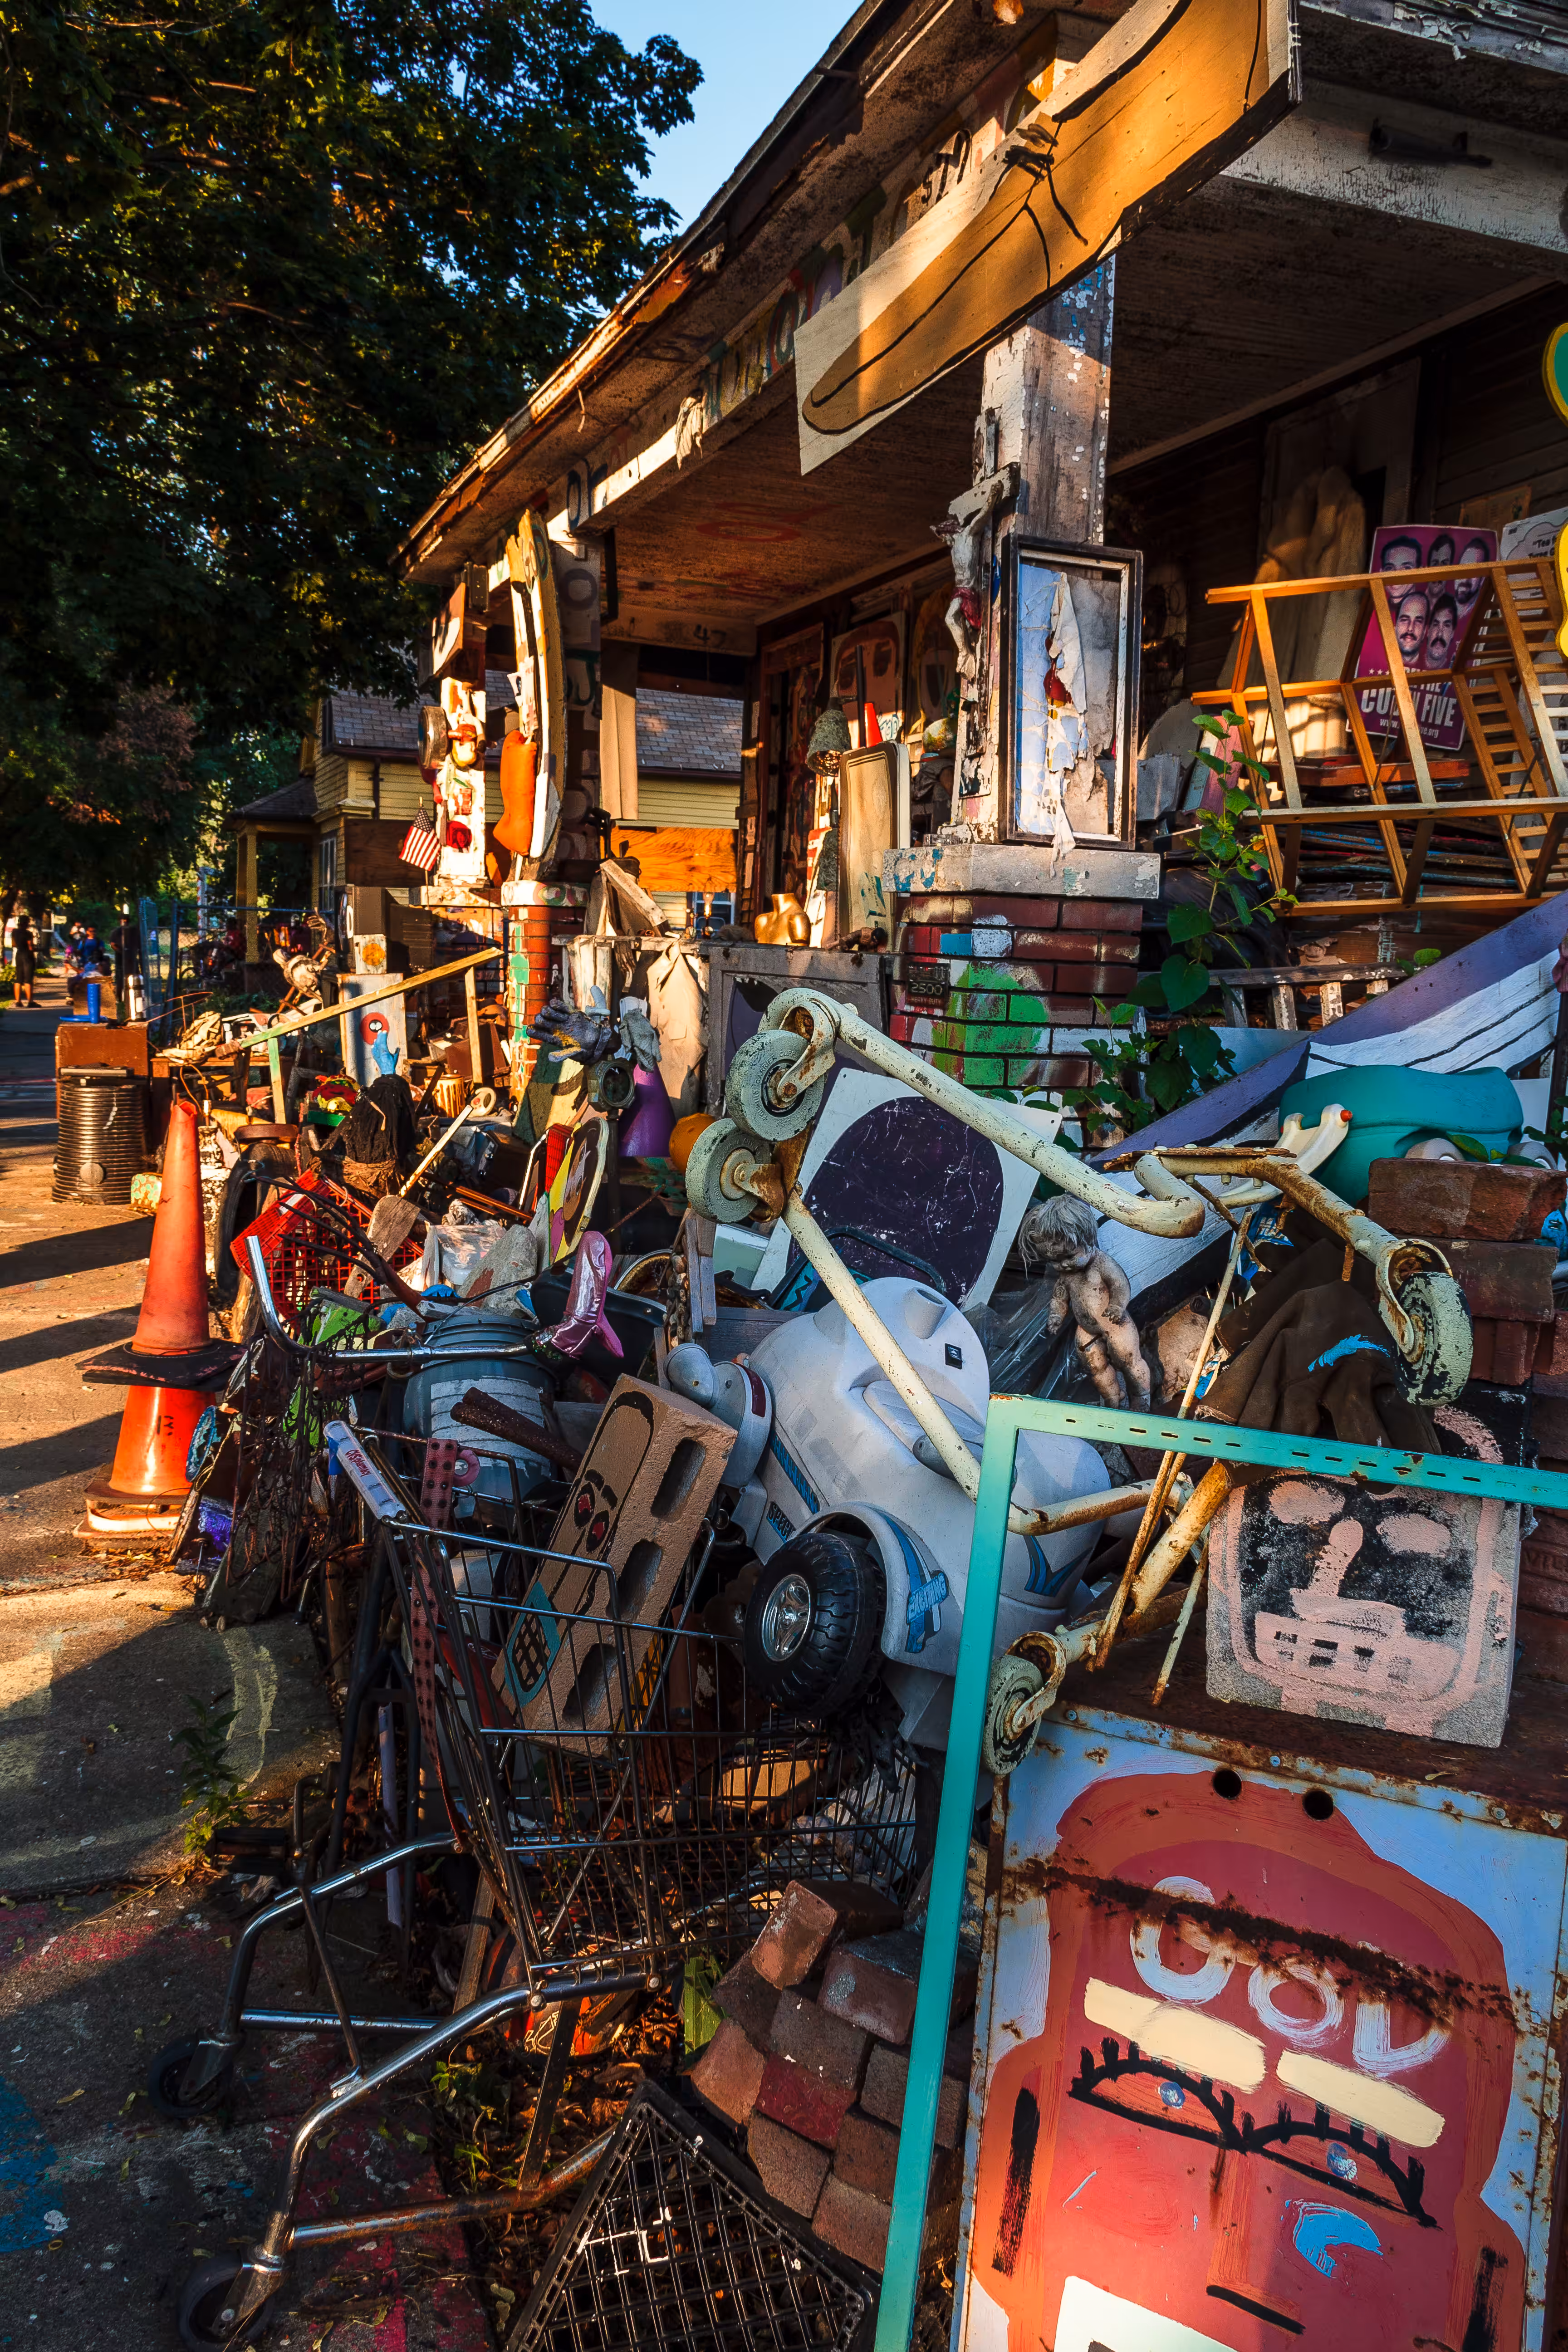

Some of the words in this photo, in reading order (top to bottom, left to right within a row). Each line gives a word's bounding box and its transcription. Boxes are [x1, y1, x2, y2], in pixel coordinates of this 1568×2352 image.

[1421, 693, 1457, 727] FIVE
[911, 982, 943, 995] 2500
[908, 1572, 947, 1621] EXCITING
